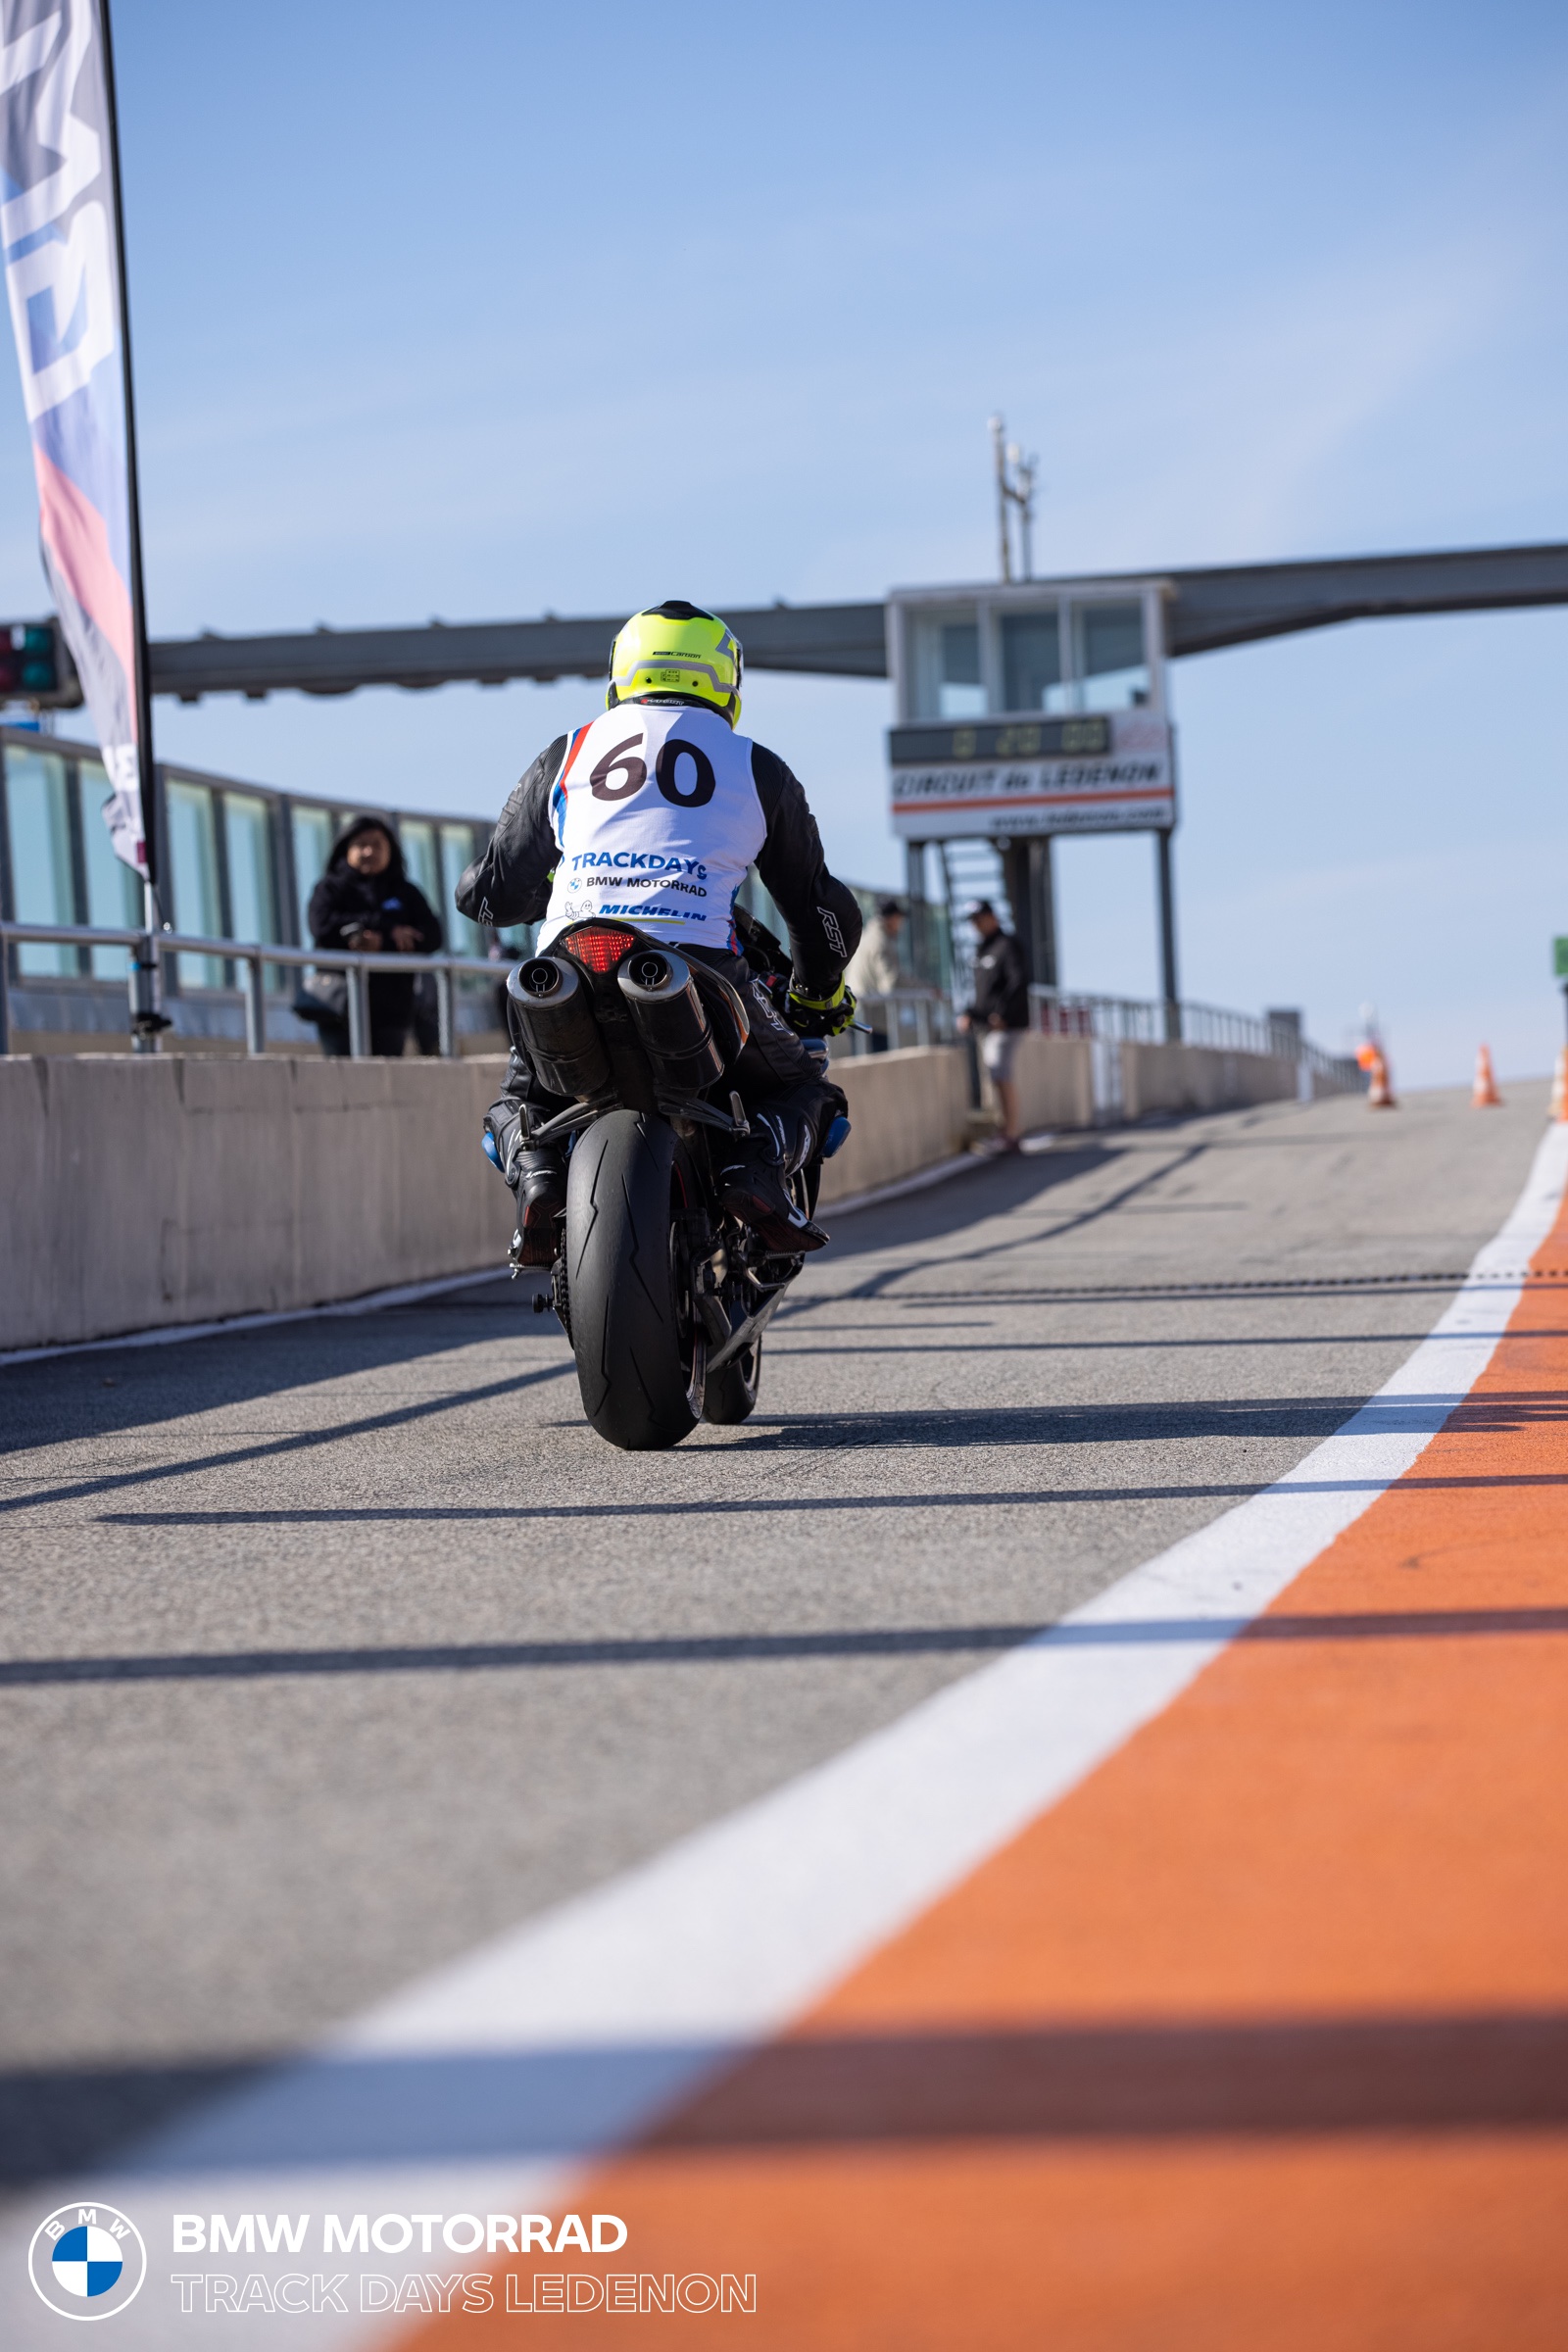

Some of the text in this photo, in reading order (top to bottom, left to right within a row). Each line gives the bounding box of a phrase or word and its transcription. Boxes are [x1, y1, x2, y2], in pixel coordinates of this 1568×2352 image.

[589, 732, 716, 808] 60
[571, 852, 708, 880] TRACKDAYS
[586, 876, 708, 898] BMW MOTORRAD
[599, 905, 707, 921] MICHELIN
[816, 906, 848, 958] RST
